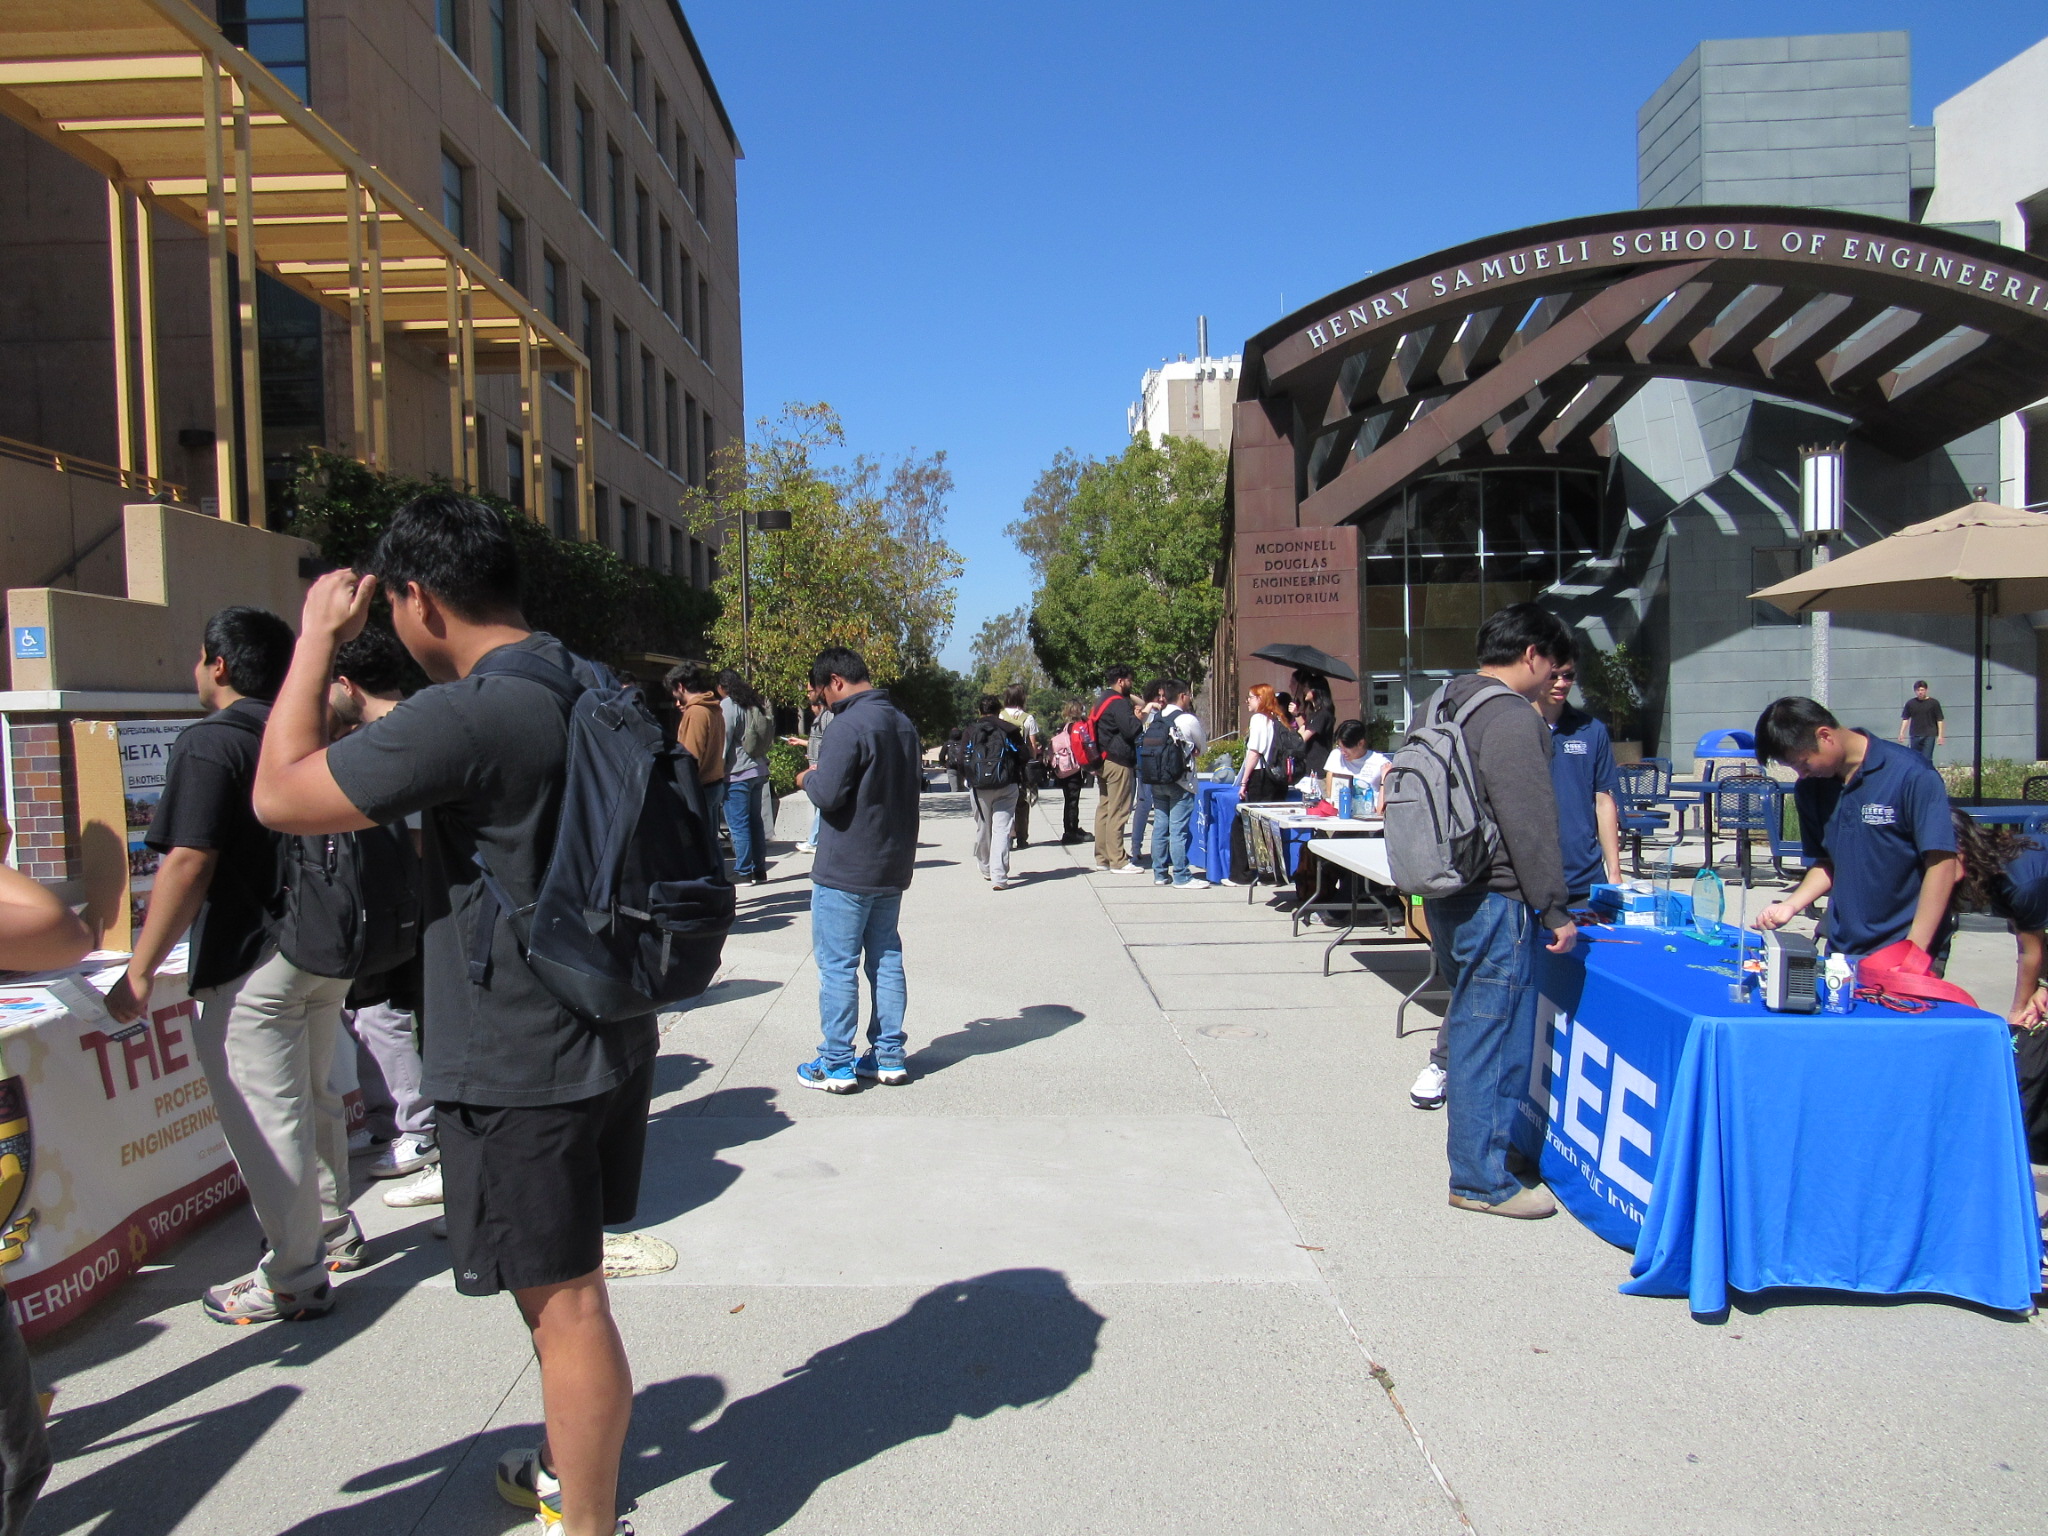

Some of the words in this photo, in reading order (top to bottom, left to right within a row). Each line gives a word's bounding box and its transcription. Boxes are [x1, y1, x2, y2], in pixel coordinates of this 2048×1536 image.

[1306, 288, 1409, 349] HENRY
[1431, 241, 1589, 298] SAMUELI
[1612, 229, 1758, 256] SCHOOL
[1782, 231, 1826, 256] OF
[1255, 541, 1336, 554] MCDONNELL
[1264, 557, 1328, 571] DOUGLAS
[1252, 574, 1340, 588] ENGINEERING
[1255, 592, 1339, 605] AUDITORIUM
[463, 1268, 478, 1280] alo
